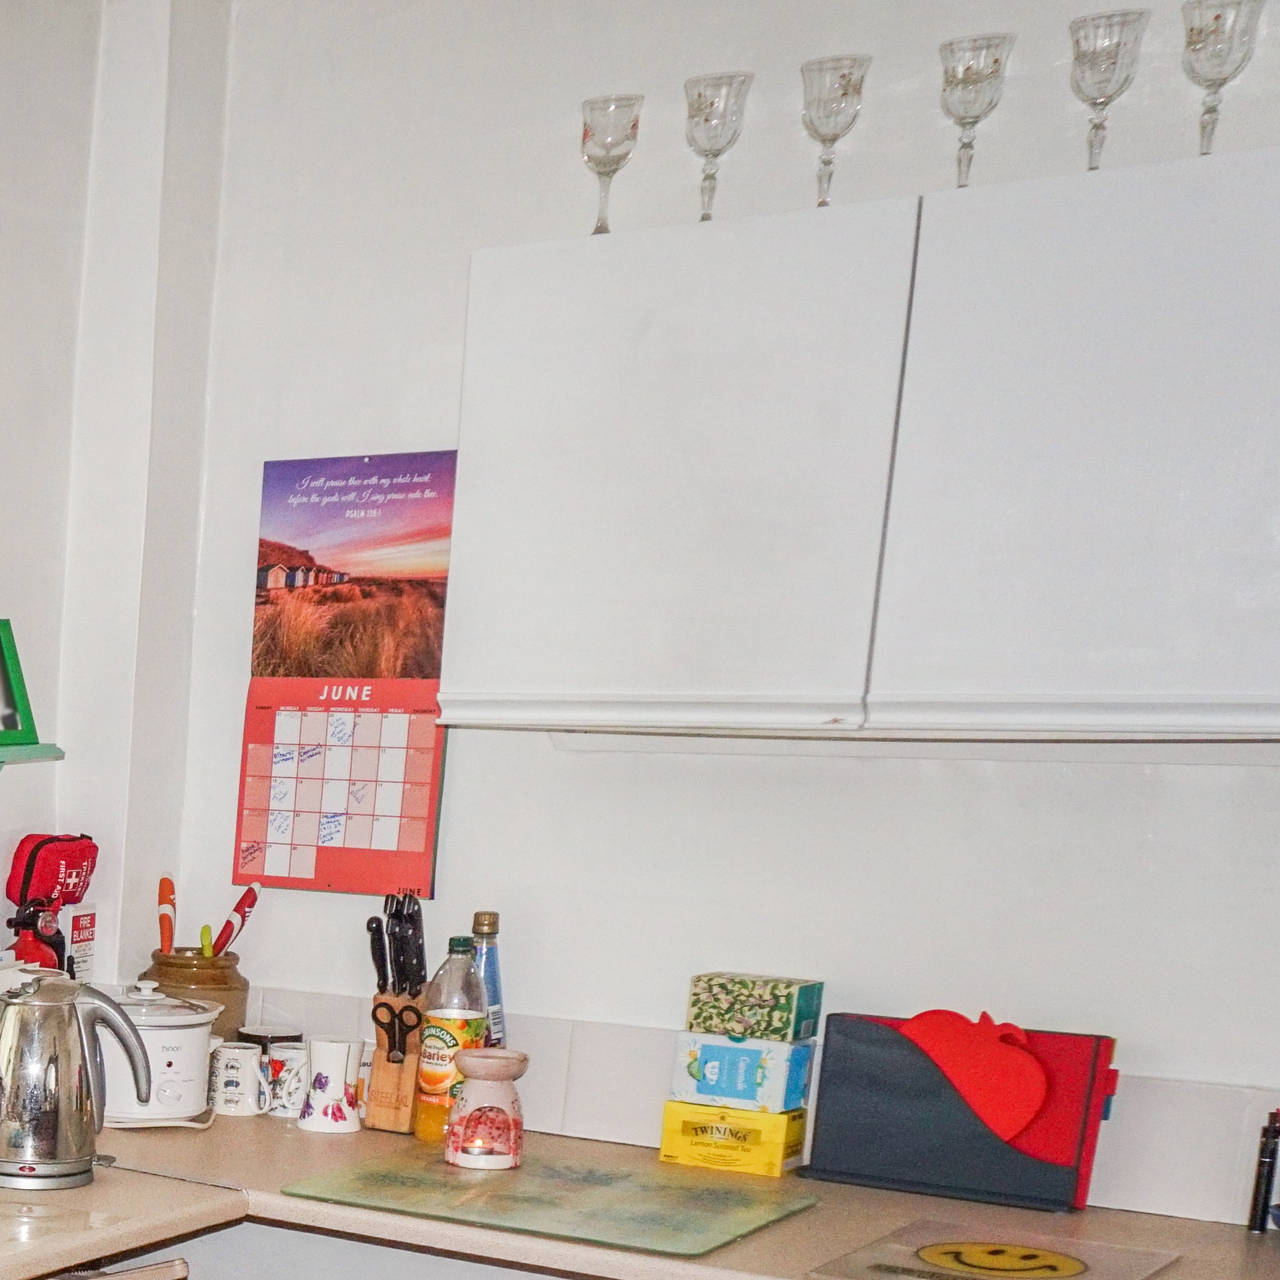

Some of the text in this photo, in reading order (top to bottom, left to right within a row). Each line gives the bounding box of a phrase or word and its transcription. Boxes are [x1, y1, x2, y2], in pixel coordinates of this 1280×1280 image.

[319, 685, 372, 701] JUNE
[51, 860, 66, 899] FIRST AID
[396, 887, 422, 897] JUNE
[80, 915, 92, 929] FIRE
[73, 928, 96, 942] BLANKE
[692, 1125, 752, 1142] TWININGS
